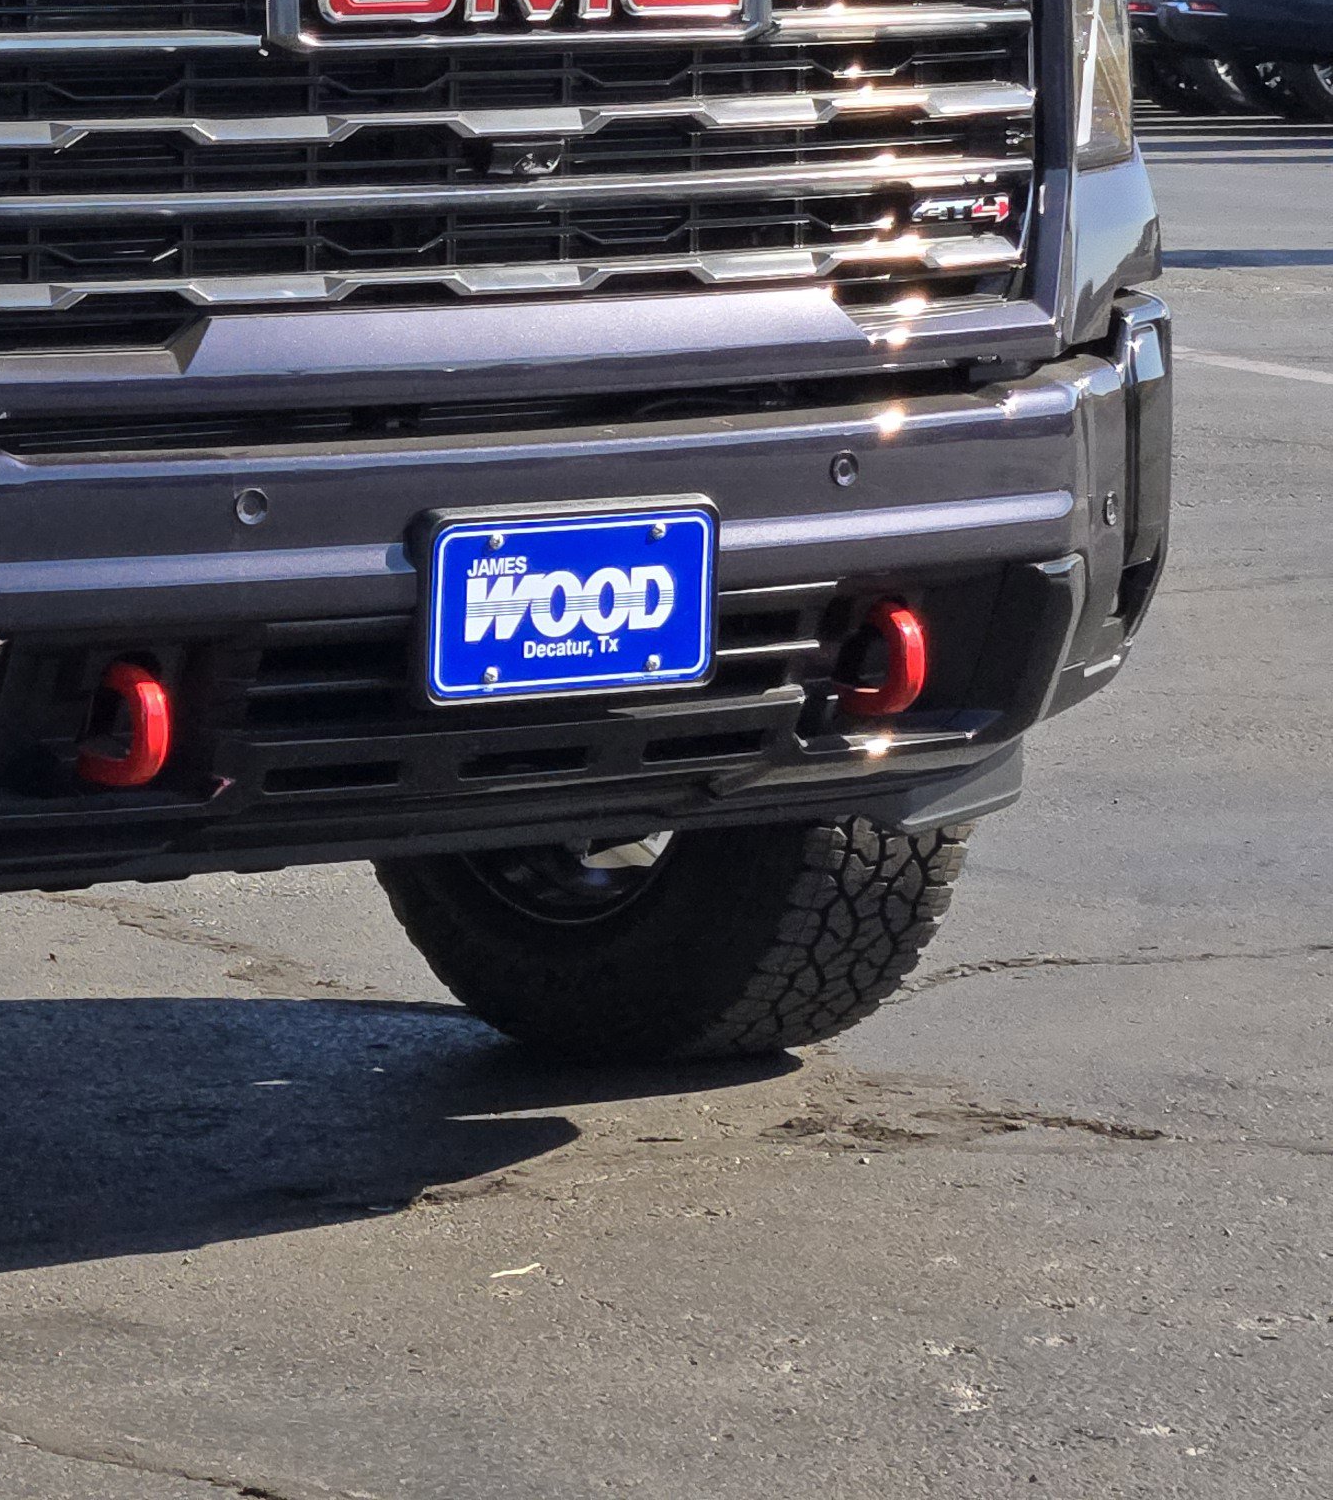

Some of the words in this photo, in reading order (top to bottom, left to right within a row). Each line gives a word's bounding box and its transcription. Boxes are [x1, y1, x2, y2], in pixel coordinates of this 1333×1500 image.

[466, 556, 527, 578] JAMES
[464, 565, 674, 643] WOOD
[523, 640, 593, 660] Decatur,
[597, 635, 619, 653] Tx
